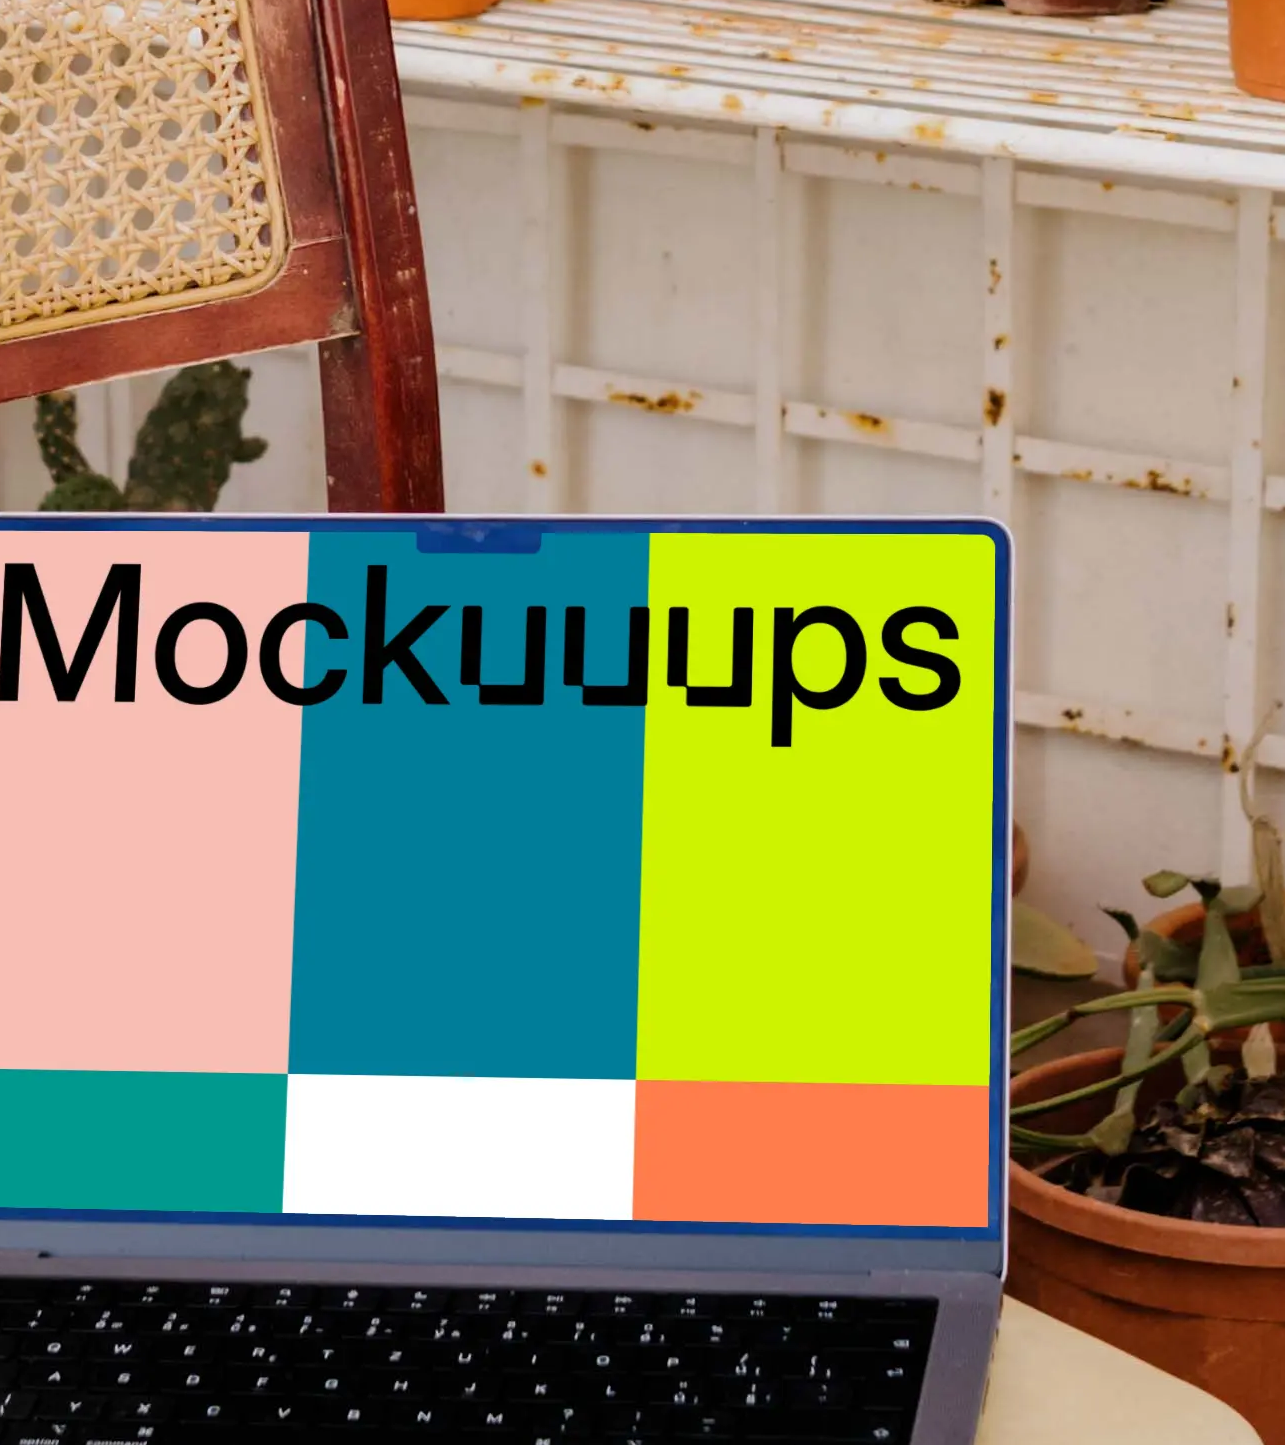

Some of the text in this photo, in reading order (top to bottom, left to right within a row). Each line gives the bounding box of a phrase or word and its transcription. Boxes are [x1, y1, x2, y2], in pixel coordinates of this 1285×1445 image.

[114, 1344, 132, 1354] W
[322, 1349, 335, 1359] T
[389, 1351, 402, 1361] Z
[458, 1352, 472, 1363] U
[48, 1371, 61, 1382] A
[393, 1380, 408, 1391] H
[534, 1384, 547, 1394] K
[70, 1401, 82, 1412] Y
[278, 1407, 291, 1418] V
[417, 1410, 432, 1422] N
[486, 1412, 503, 1424] M
